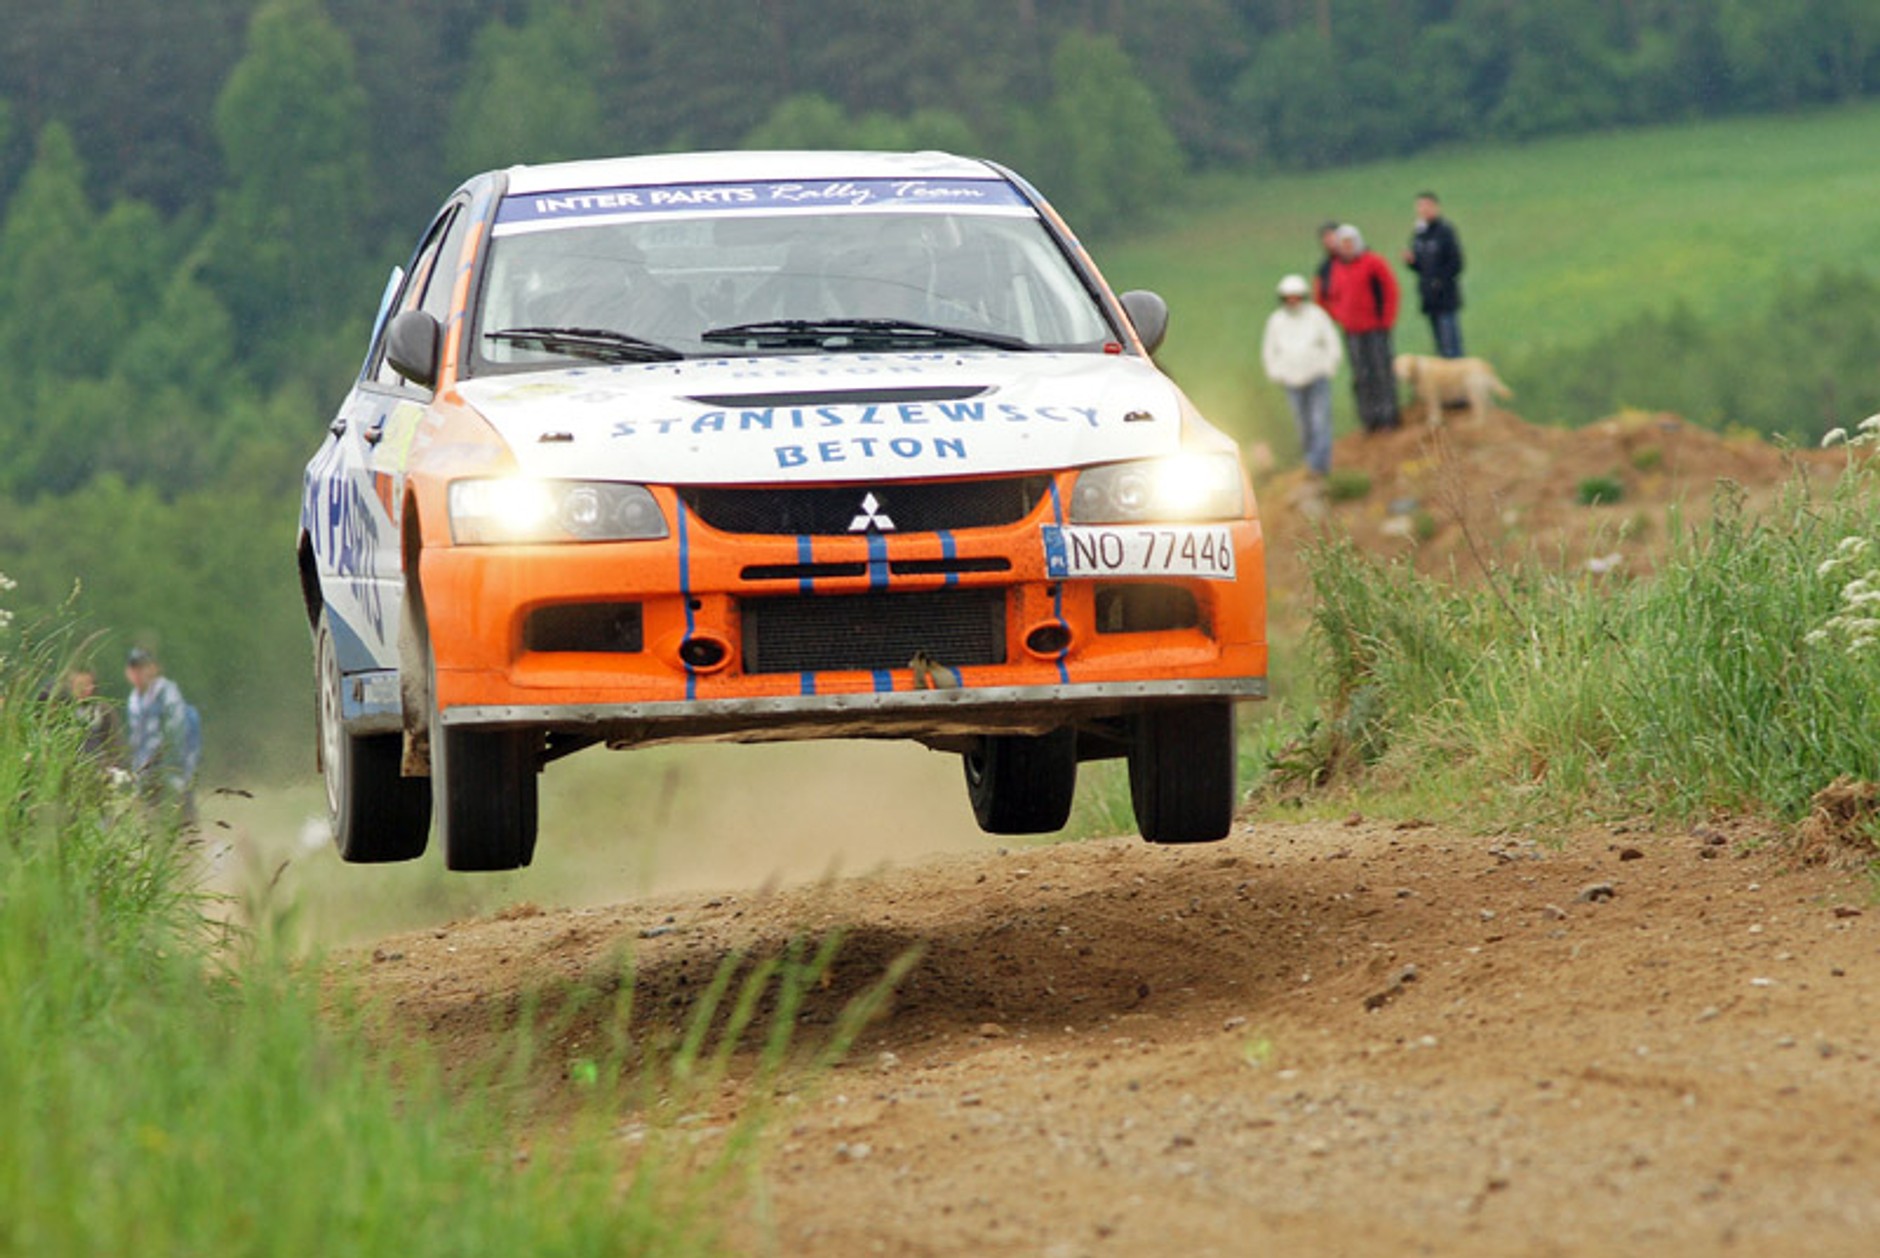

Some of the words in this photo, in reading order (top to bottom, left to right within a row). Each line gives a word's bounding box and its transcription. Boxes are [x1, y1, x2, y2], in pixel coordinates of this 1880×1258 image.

[535, 192, 643, 213] INTER
[651, 187, 758, 205] PARTS
[771, 182, 873, 206] Rally
[890, 181, 984, 198] Team
[610, 402, 1098, 438] STANISZEWSCY
[773, 437, 967, 469] BETON
[1070, 532, 1125, 570] NO
[1138, 531, 1231, 572] 77446
